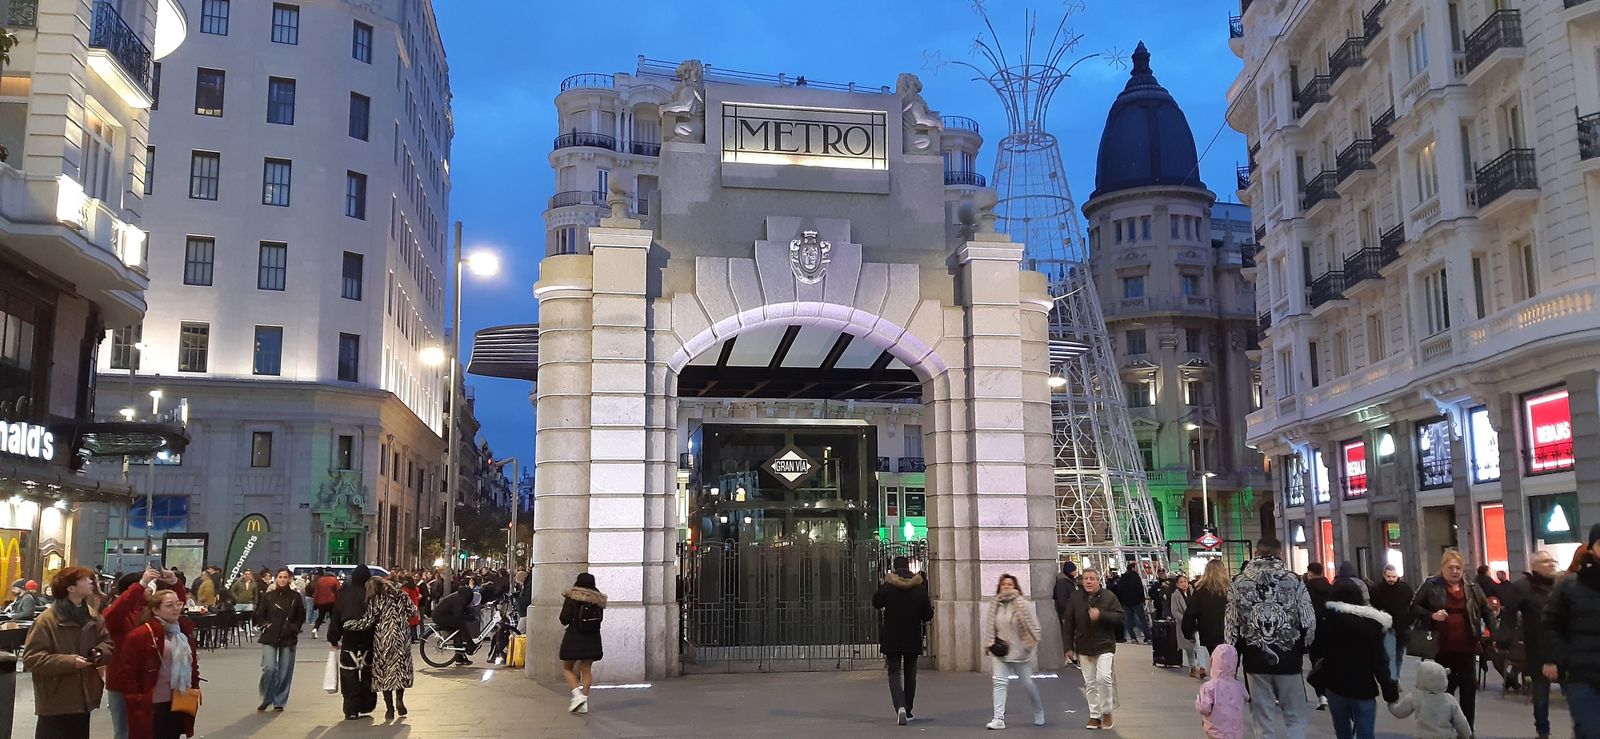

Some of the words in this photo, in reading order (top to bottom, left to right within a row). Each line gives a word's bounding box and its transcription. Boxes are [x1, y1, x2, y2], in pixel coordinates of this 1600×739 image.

[738, 119, 871, 155] METRO
[776, 460, 795, 472] GRAN
[224, 535, 258, 590] McDonald's
